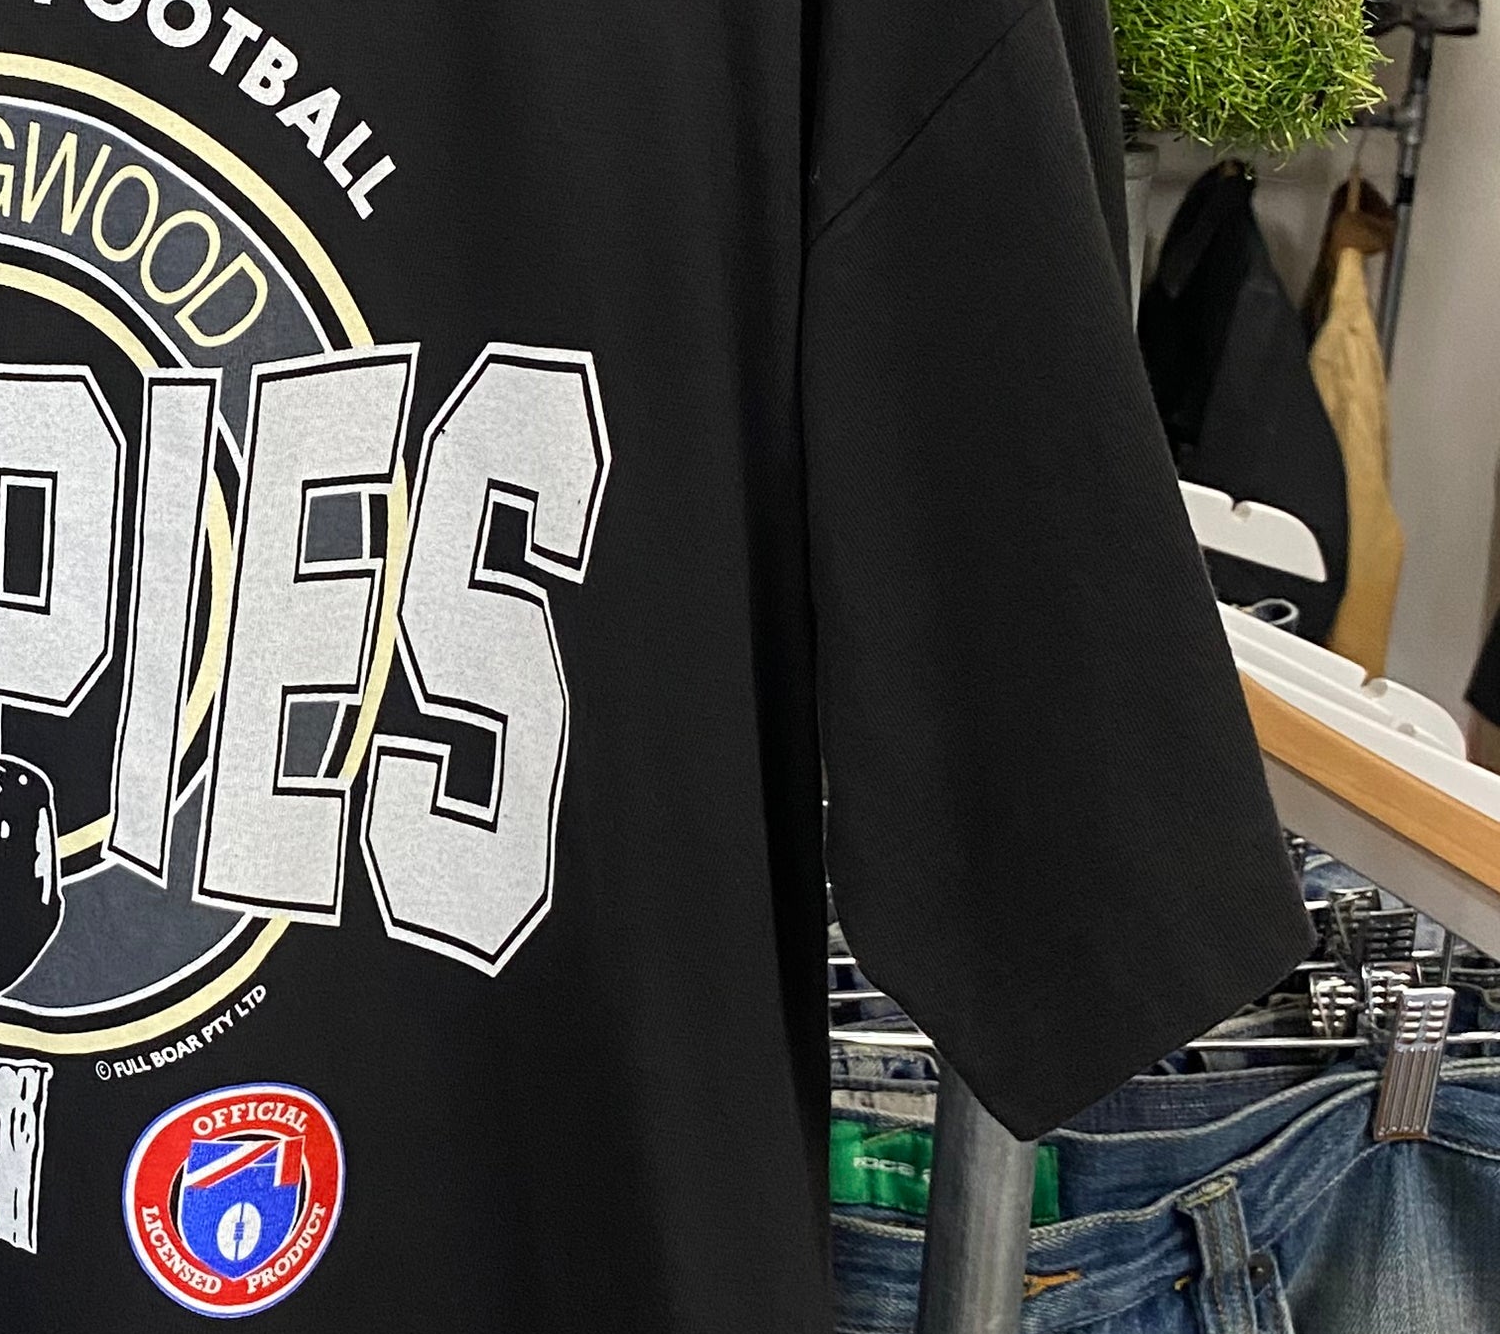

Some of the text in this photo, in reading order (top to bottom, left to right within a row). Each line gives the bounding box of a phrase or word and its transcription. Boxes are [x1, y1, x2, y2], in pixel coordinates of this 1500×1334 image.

[113, 1056, 151, 1078] FULL
[150, 1034, 203, 1067] BOAR
[201, 1009, 233, 1043] PTY
[234, 985, 267, 1017] LTD
[192, 1101, 309, 1135] OFFICIAL
[141, 1202, 326, 1294] LICENSED PRODUCT
